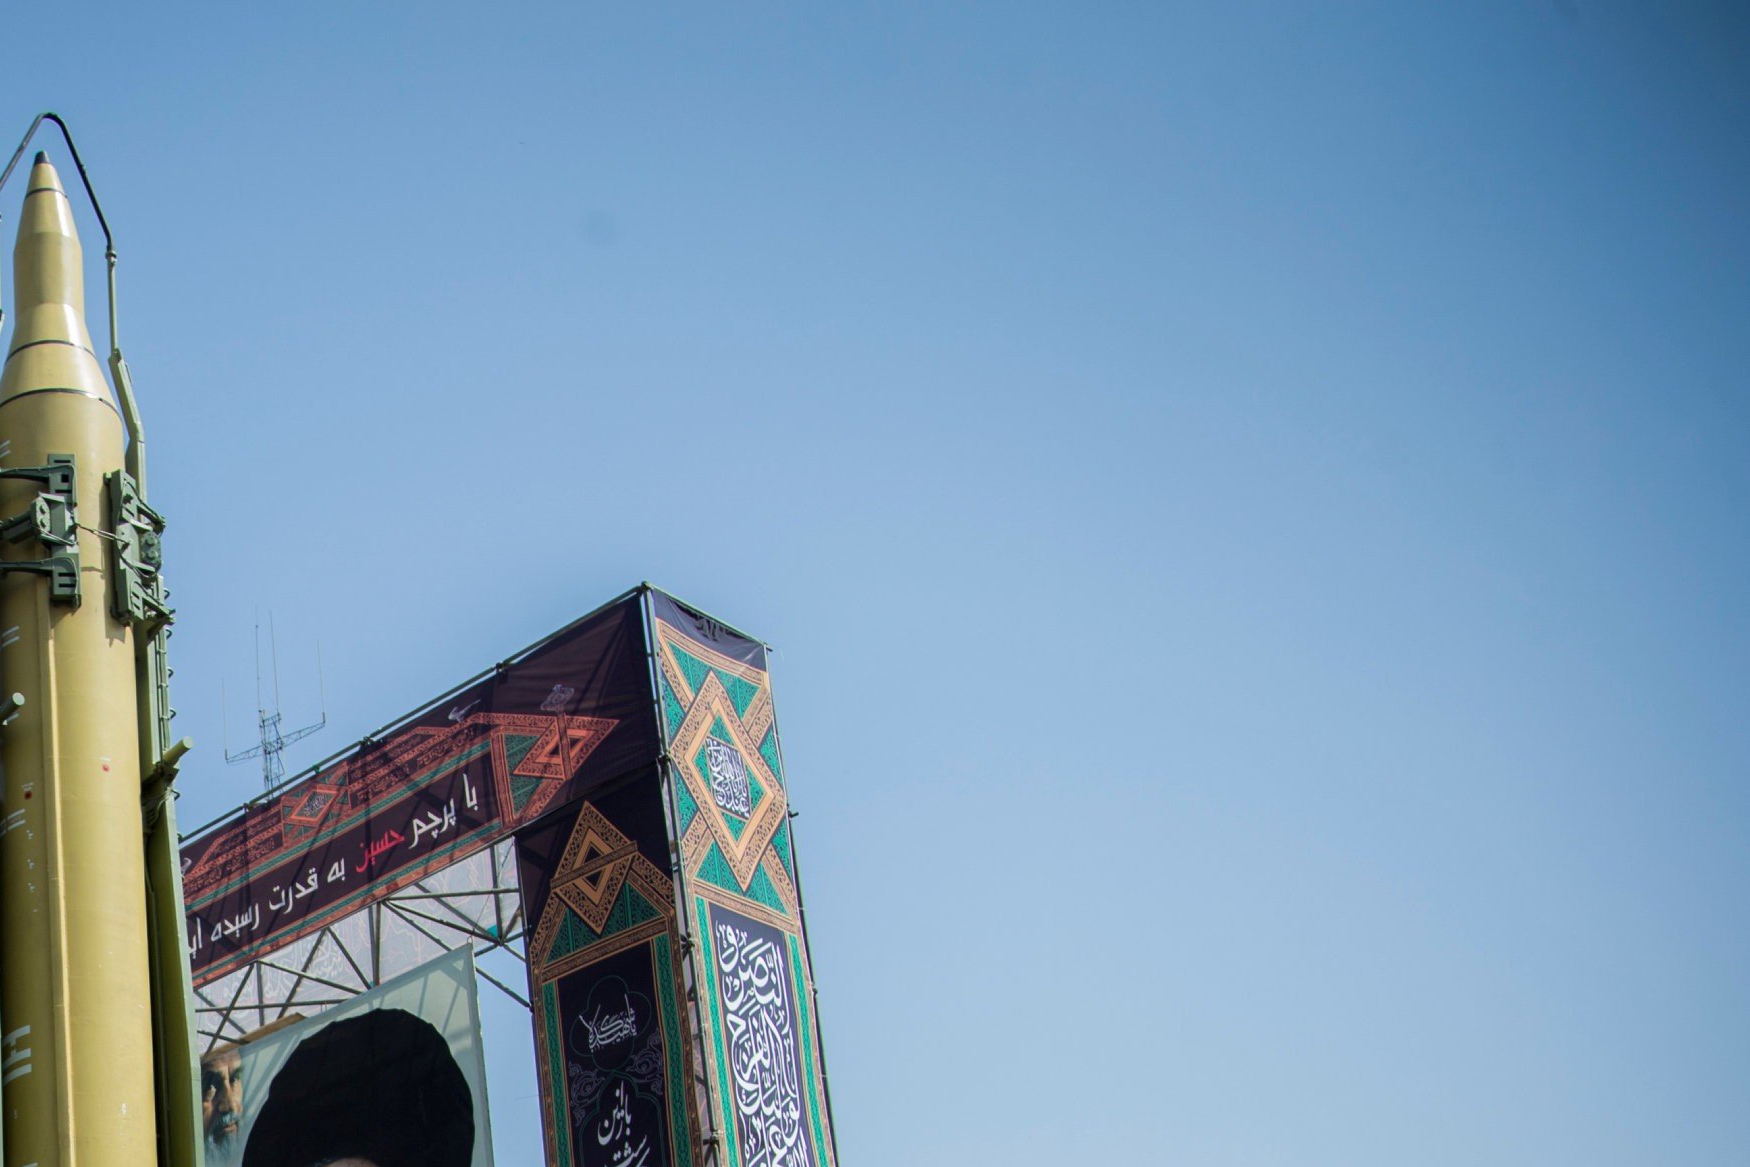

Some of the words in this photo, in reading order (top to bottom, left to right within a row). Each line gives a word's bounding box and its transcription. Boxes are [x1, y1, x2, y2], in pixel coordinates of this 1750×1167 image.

[462, 773, 478, 811] با
[408, 798, 456, 849] پرچم
[327, 858, 346, 882] به
[356, 828, 405, 873] حسین
[269, 867, 319, 915] قدرت
[210, 904, 261, 943] رسیده
